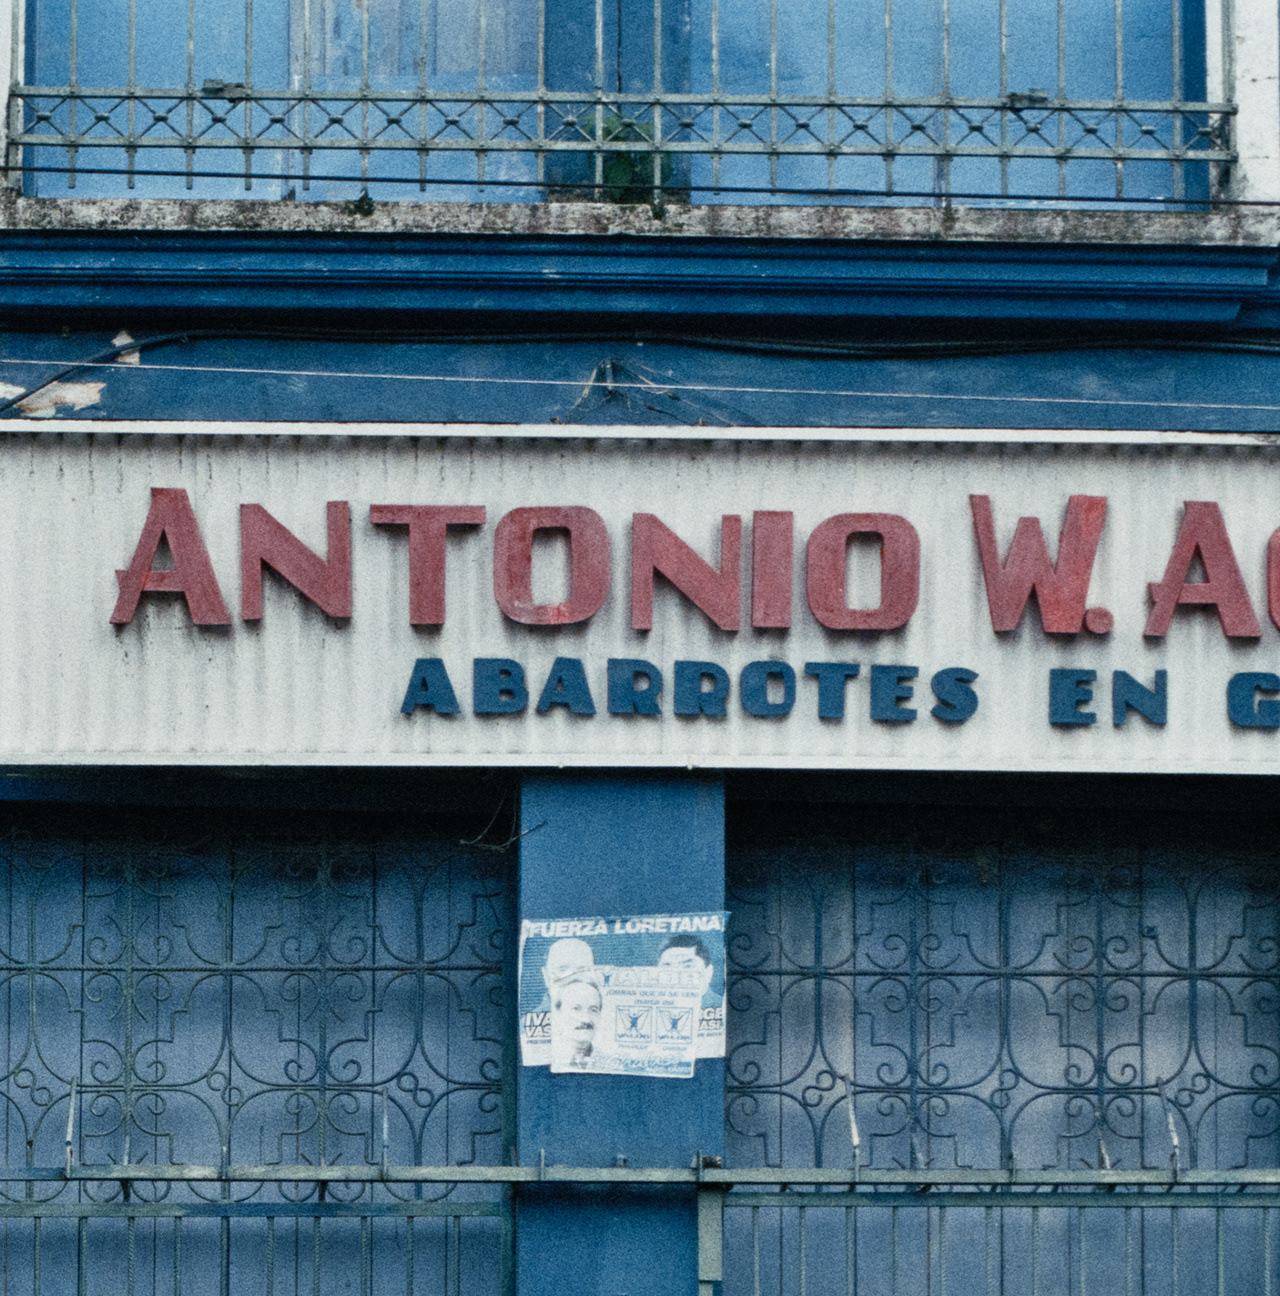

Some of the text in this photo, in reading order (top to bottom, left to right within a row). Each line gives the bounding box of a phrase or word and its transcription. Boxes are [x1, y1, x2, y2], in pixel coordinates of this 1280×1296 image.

[109, 486, 921, 633] ANTONIO
[969, 494, 1114, 634] W.
[401, 658, 979, 724] ABARROTES
[1048, 668, 1168, 728] EN
